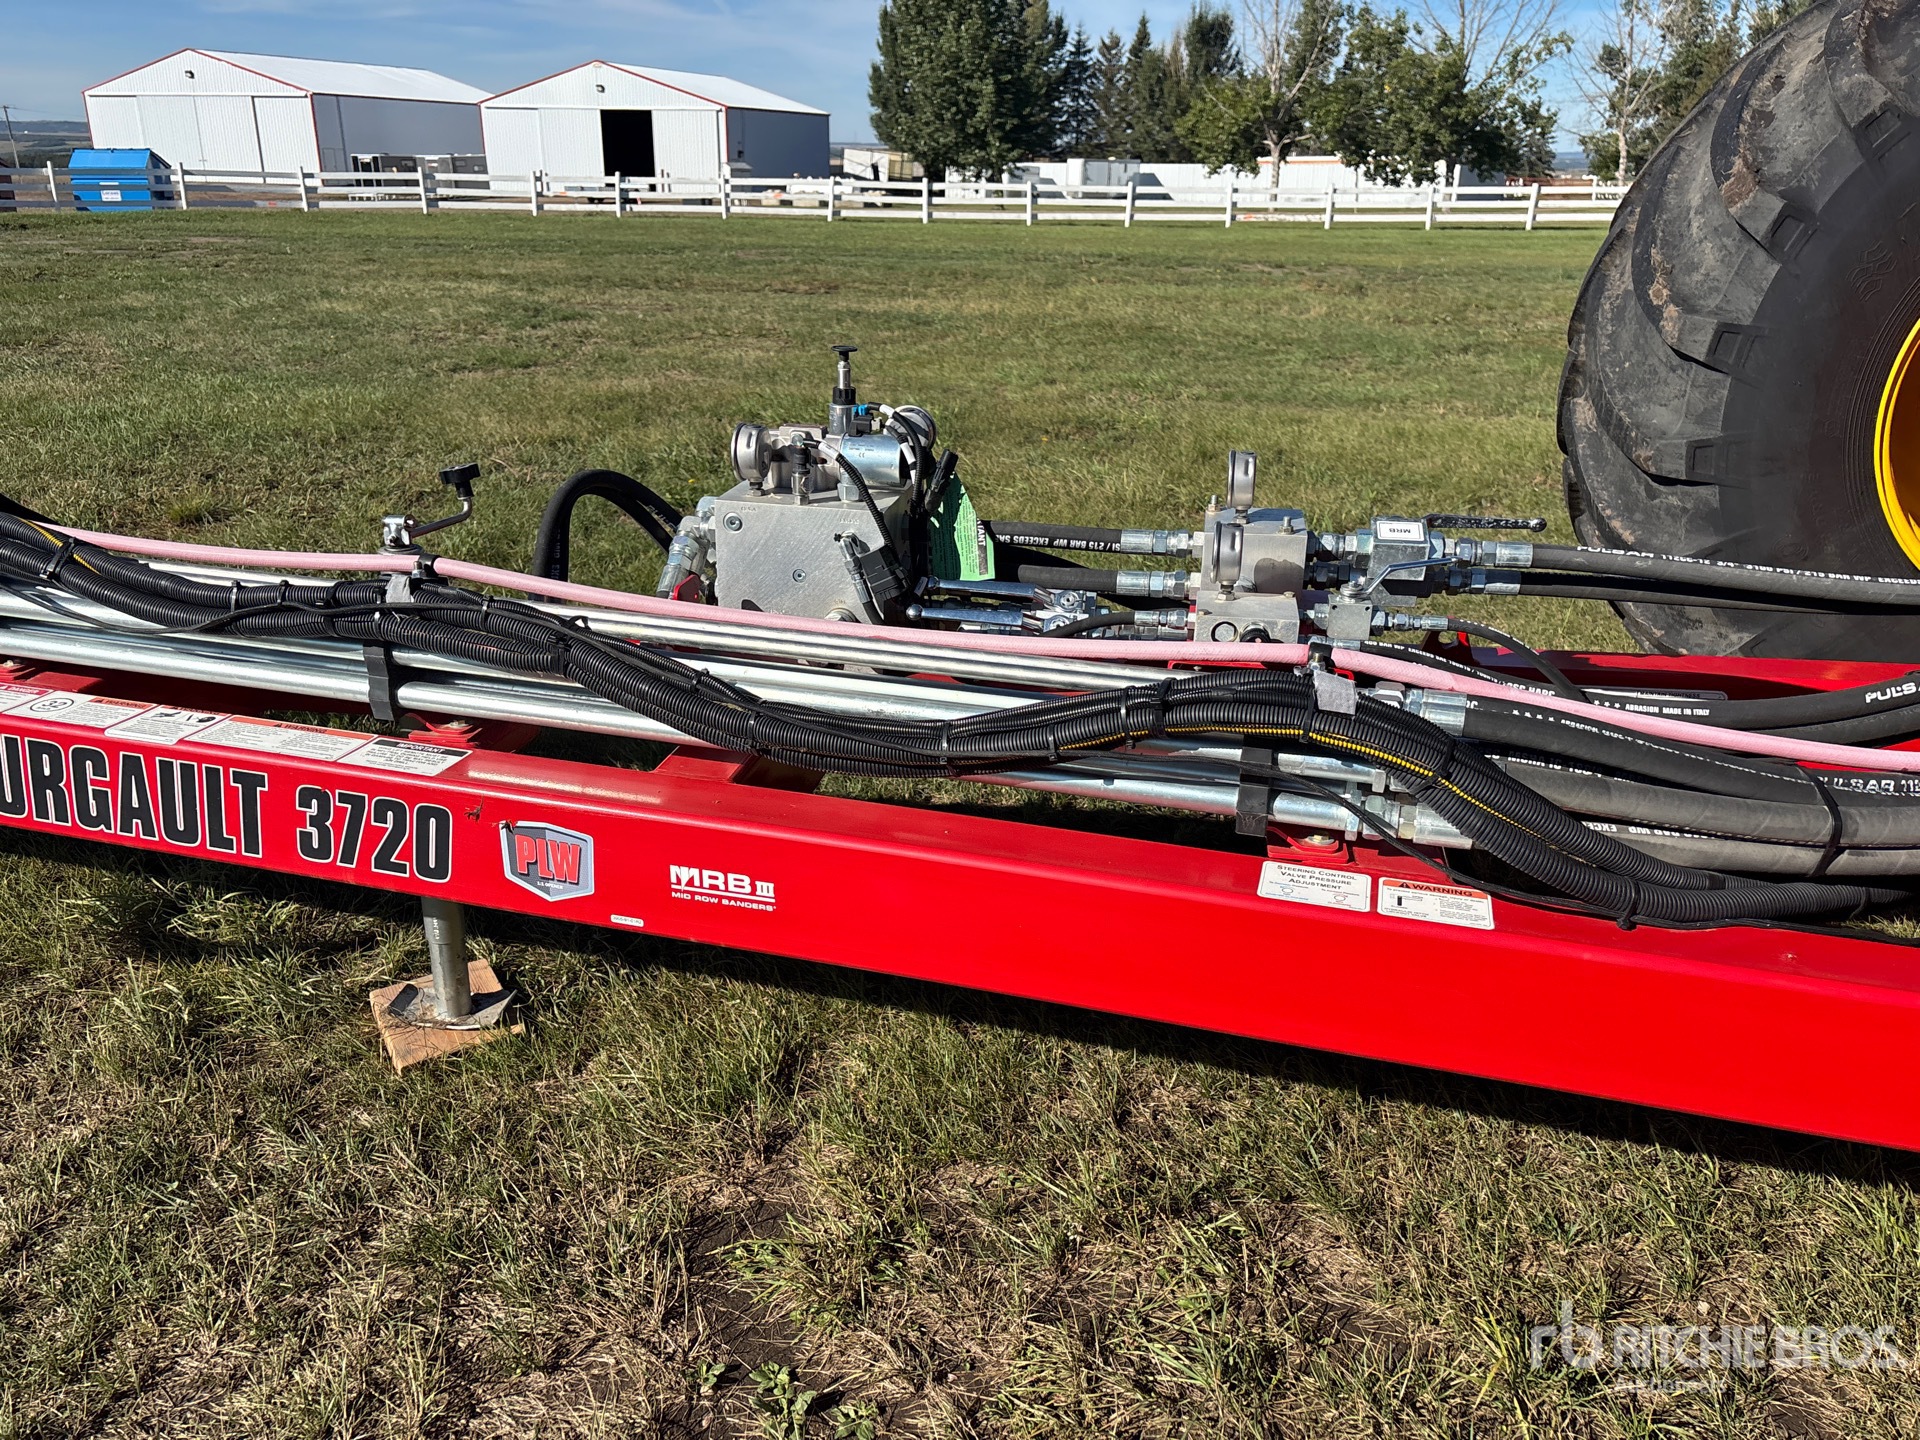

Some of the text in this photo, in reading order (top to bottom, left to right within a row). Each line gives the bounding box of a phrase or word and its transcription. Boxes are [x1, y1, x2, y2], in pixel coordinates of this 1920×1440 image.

[976, 518, 987, 547] TANT
[1013, 535, 1049, 546] EXCEEDS
[1053, 538, 1068, 548] WP
[1069, 540, 1086, 549] BAR
[1089, 541, 1104, 551] 215
[1577, 546, 1654, 558] PULSAR
[1865, 682, 1920, 704] PULS
[1625, 703, 1711, 717] ABRASION MADE IN ITALY
[395, 742, 446, 754] IMPORTANT
[295, 784, 453, 885] 3720
[514, 834, 582, 884] PLW
[1277, 865, 1357, 881] STEERING CONTROL
[1280, 871, 1352, 886] VALVE PRESSURE
[669, 864, 776, 898] MRB III
[1288, 878, 1342, 891] ADJUSTMENT
[1412, 883, 1473, 897] WARNING
[671, 891, 692, 900] MID
[694, 894, 719, 904] ROW
